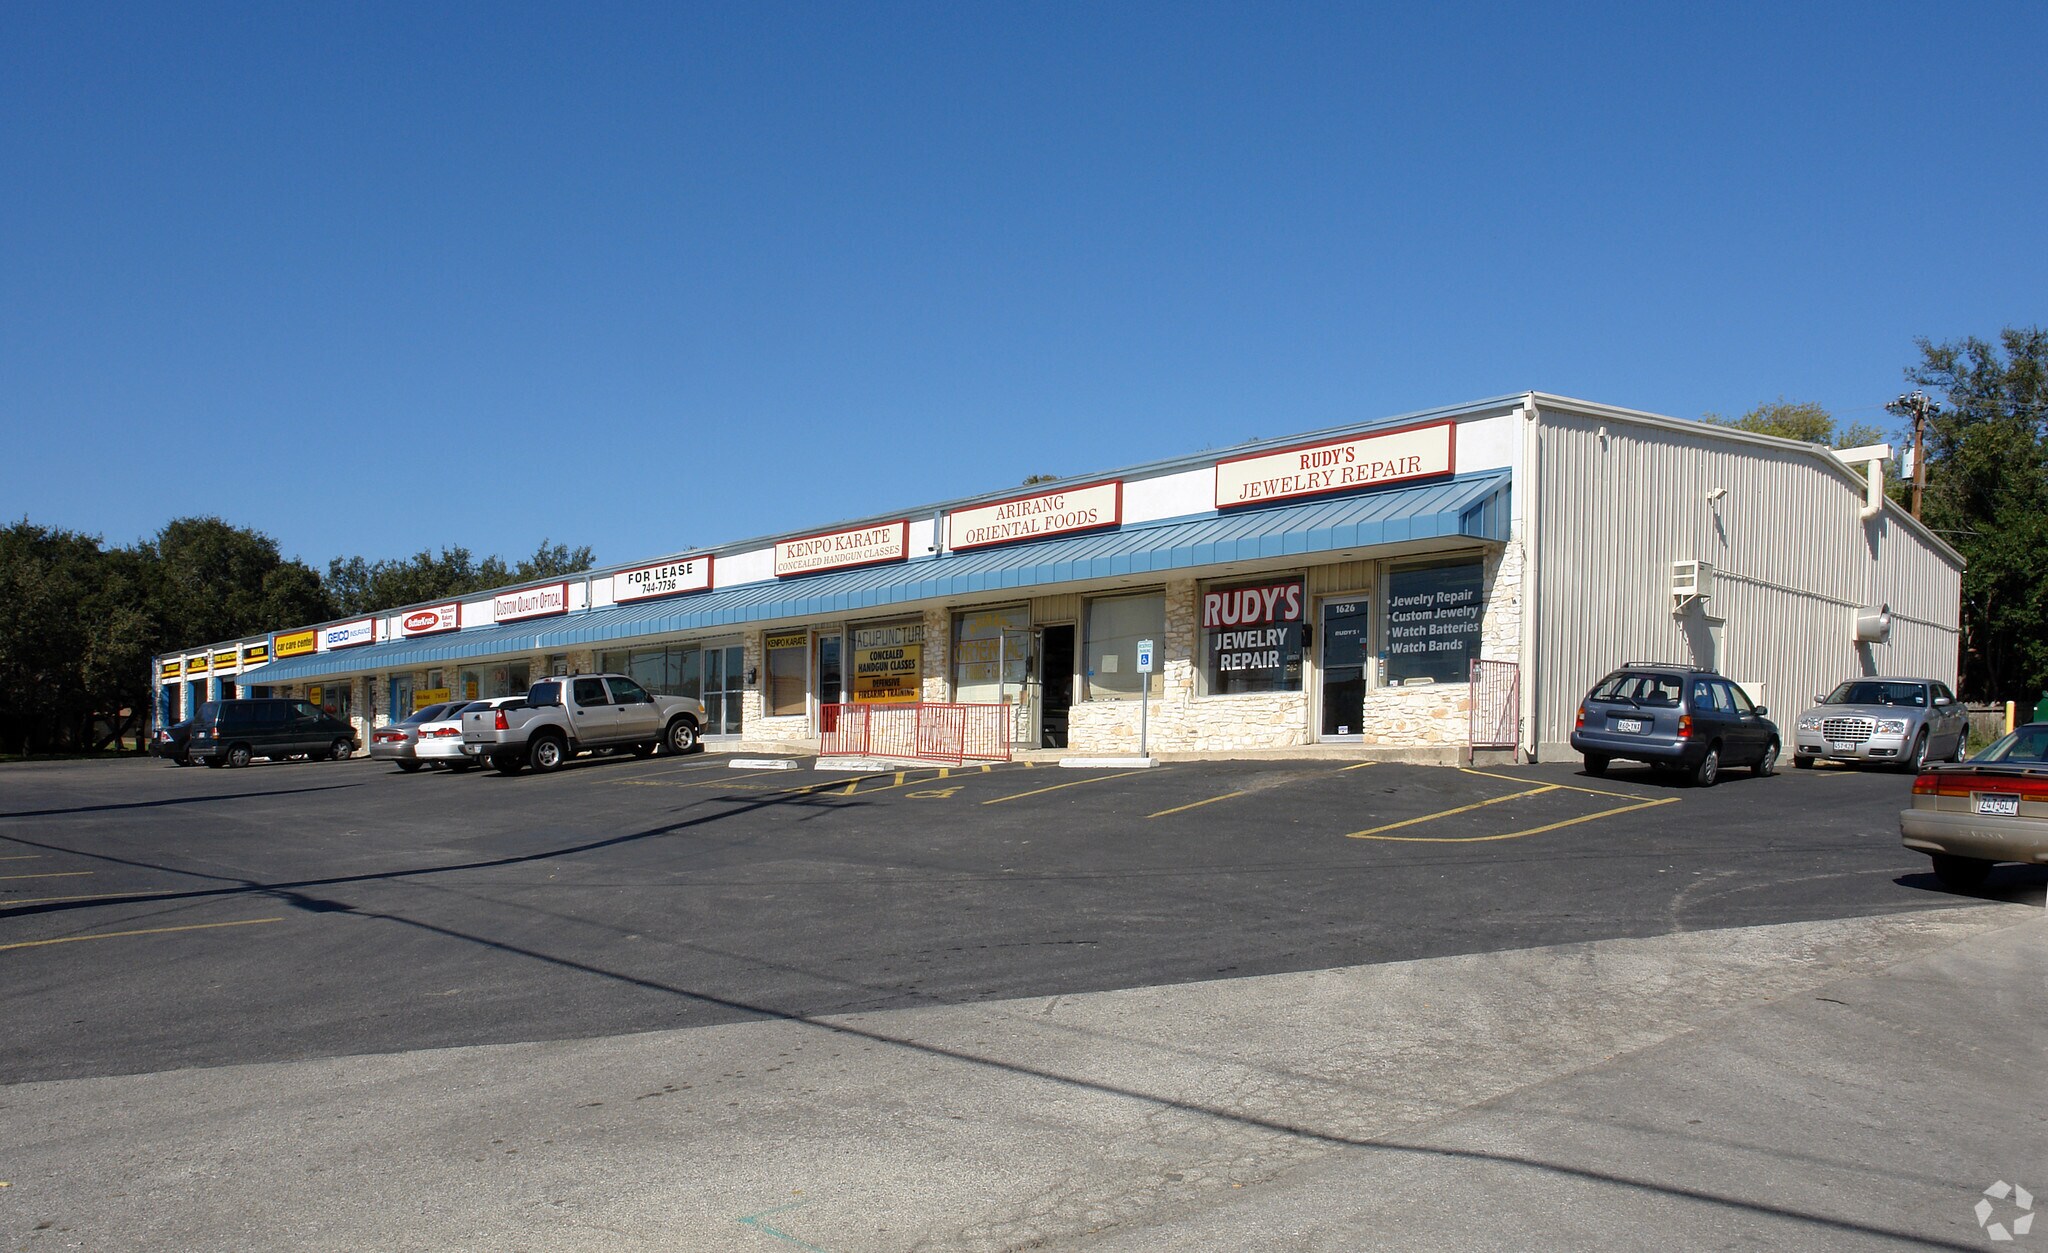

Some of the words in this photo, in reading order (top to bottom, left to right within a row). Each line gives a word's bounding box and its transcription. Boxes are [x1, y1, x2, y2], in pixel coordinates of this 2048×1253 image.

[1299, 446, 1356, 471] RUDY'S
[1239, 469, 1335, 500] JEWELRY
[1341, 455, 1422, 485] REPAIR
[995, 495, 1065, 521] ARIRANG
[965, 518, 1040, 544] ORIENTAL
[1044, 508, 1098, 531] FOODS
[786, 538, 832, 559] KENPO
[835, 528, 890, 551] KARATE
[777, 557, 823, 572] CONCEALED
[823, 550, 862, 565] HANDGUN
[863, 544, 900, 559] CLASSES
[628, 570, 650, 584] FOR
[655, 563, 693, 580] LEASE
[642, 578, 676, 594] 744-7736
[1203, 584, 1300, 627] RUDY'S
[1391, 594, 1434, 607] Jewelry
[1436, 589, 1473, 605] Repair
[1335, 604, 1356, 613] 1626
[1391, 610, 1432, 622] Custom
[1434, 605, 1479, 619] Jewelry
[327, 629, 350, 644] GEICO
[856, 625, 925, 648] ACUPUNCTURE
[1391, 625, 1426, 638] Watch
[1428, 621, 1479, 635] Batteries
[277, 643, 286, 652] car
[285, 641, 297, 650] care
[297, 637, 313, 648] center
[767, 638, 785, 648] KENPO
[786, 636, 806, 646] KARATE
[1215, 627, 1288, 651] JEWELRY
[1391, 641, 1426, 654] Watch
[1428, 639, 1463, 652] Bands
[869, 649, 904, 661] CONCEALED
[1220, 650, 1280, 672] REPAIR
[858, 661, 889, 673] HANDGUN
[890, 659, 916, 671] CLASSES
[872, 677, 900, 688] DEFENSIVE
[858, 688, 886, 699] FIREARMS
[887, 687, 915, 698] TRAINING
